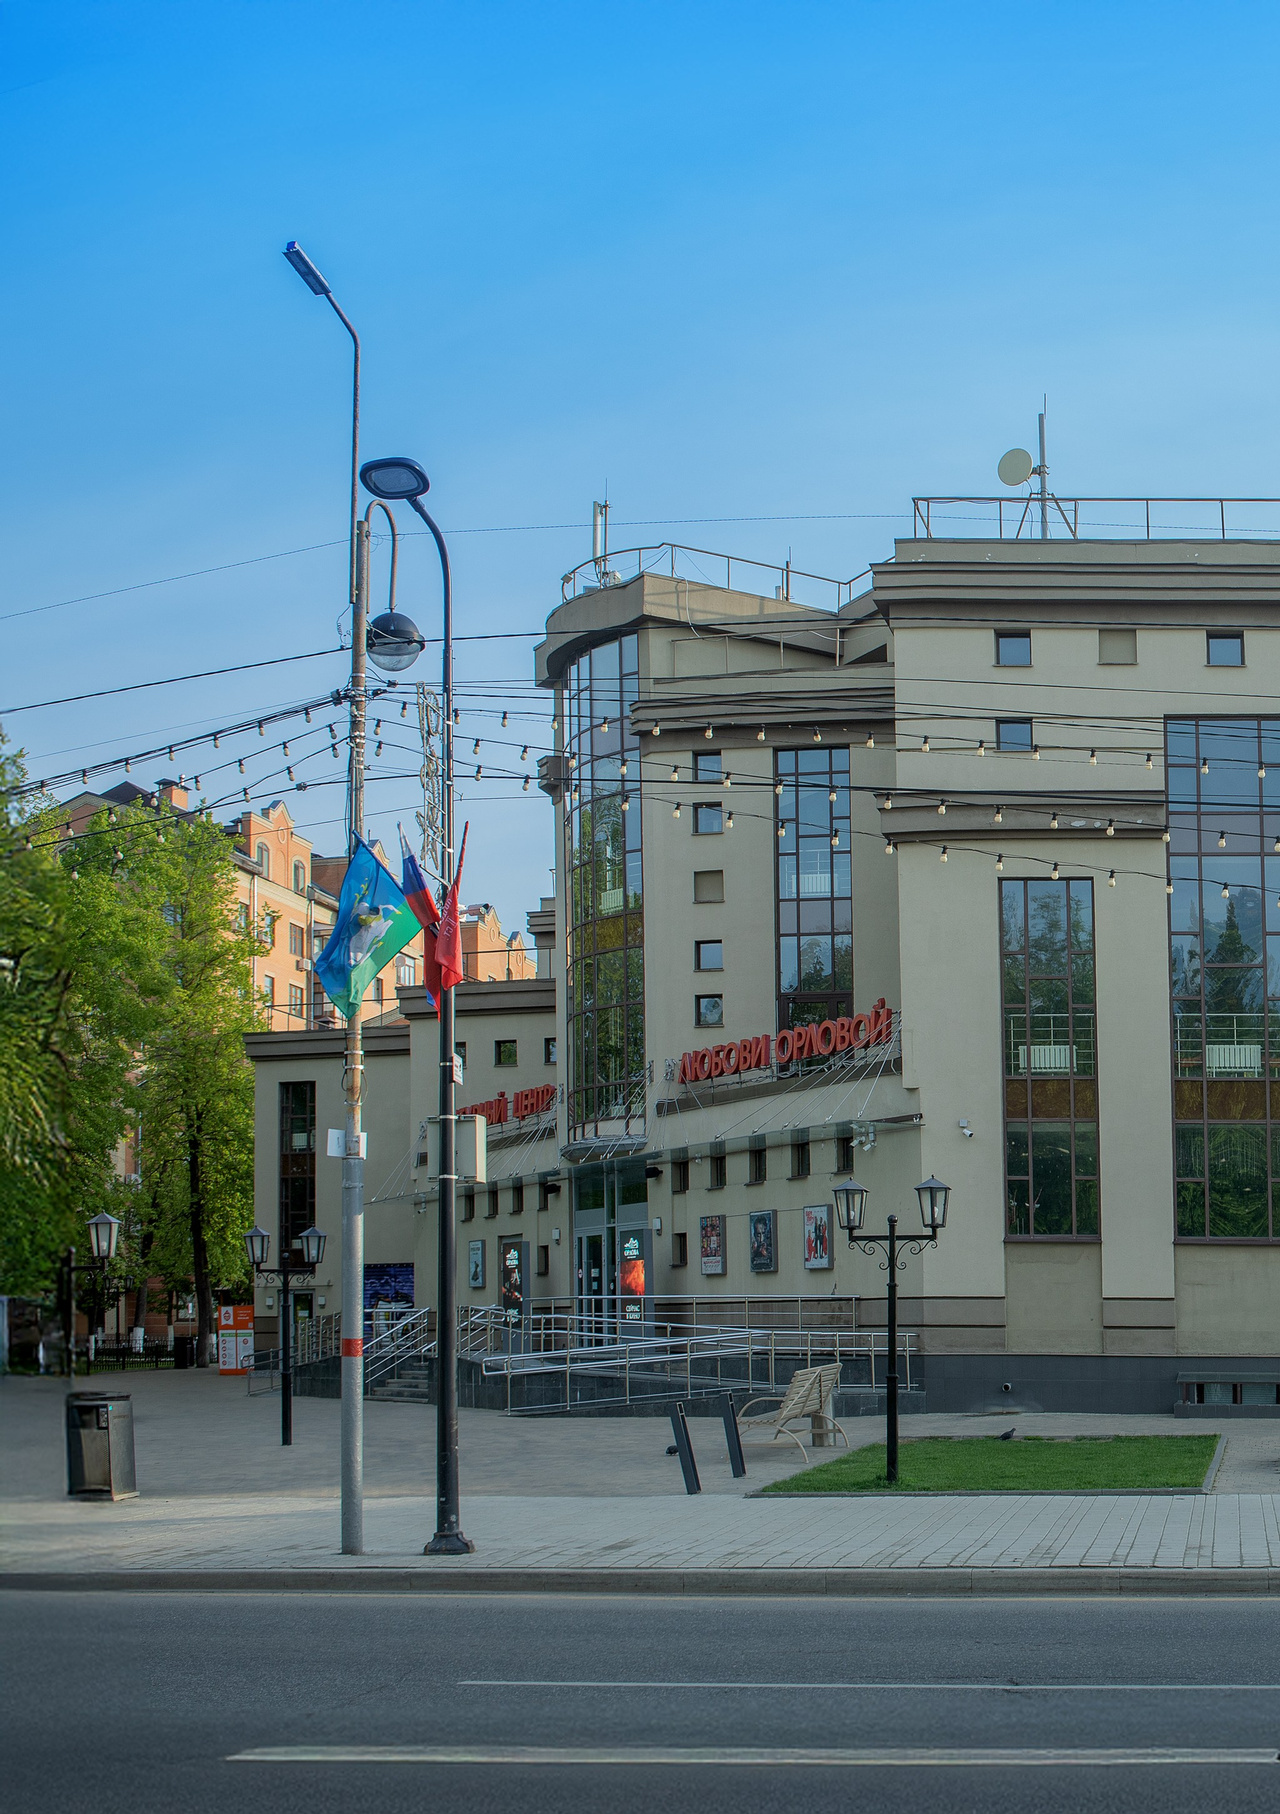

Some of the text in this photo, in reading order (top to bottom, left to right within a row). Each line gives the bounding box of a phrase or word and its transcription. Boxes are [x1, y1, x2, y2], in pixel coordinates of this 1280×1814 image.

[678, 997, 893, 1084] ЛЮБОВИ ОРЛОВОЙ
[513, 1083, 556, 1120] ЦЕНТР
